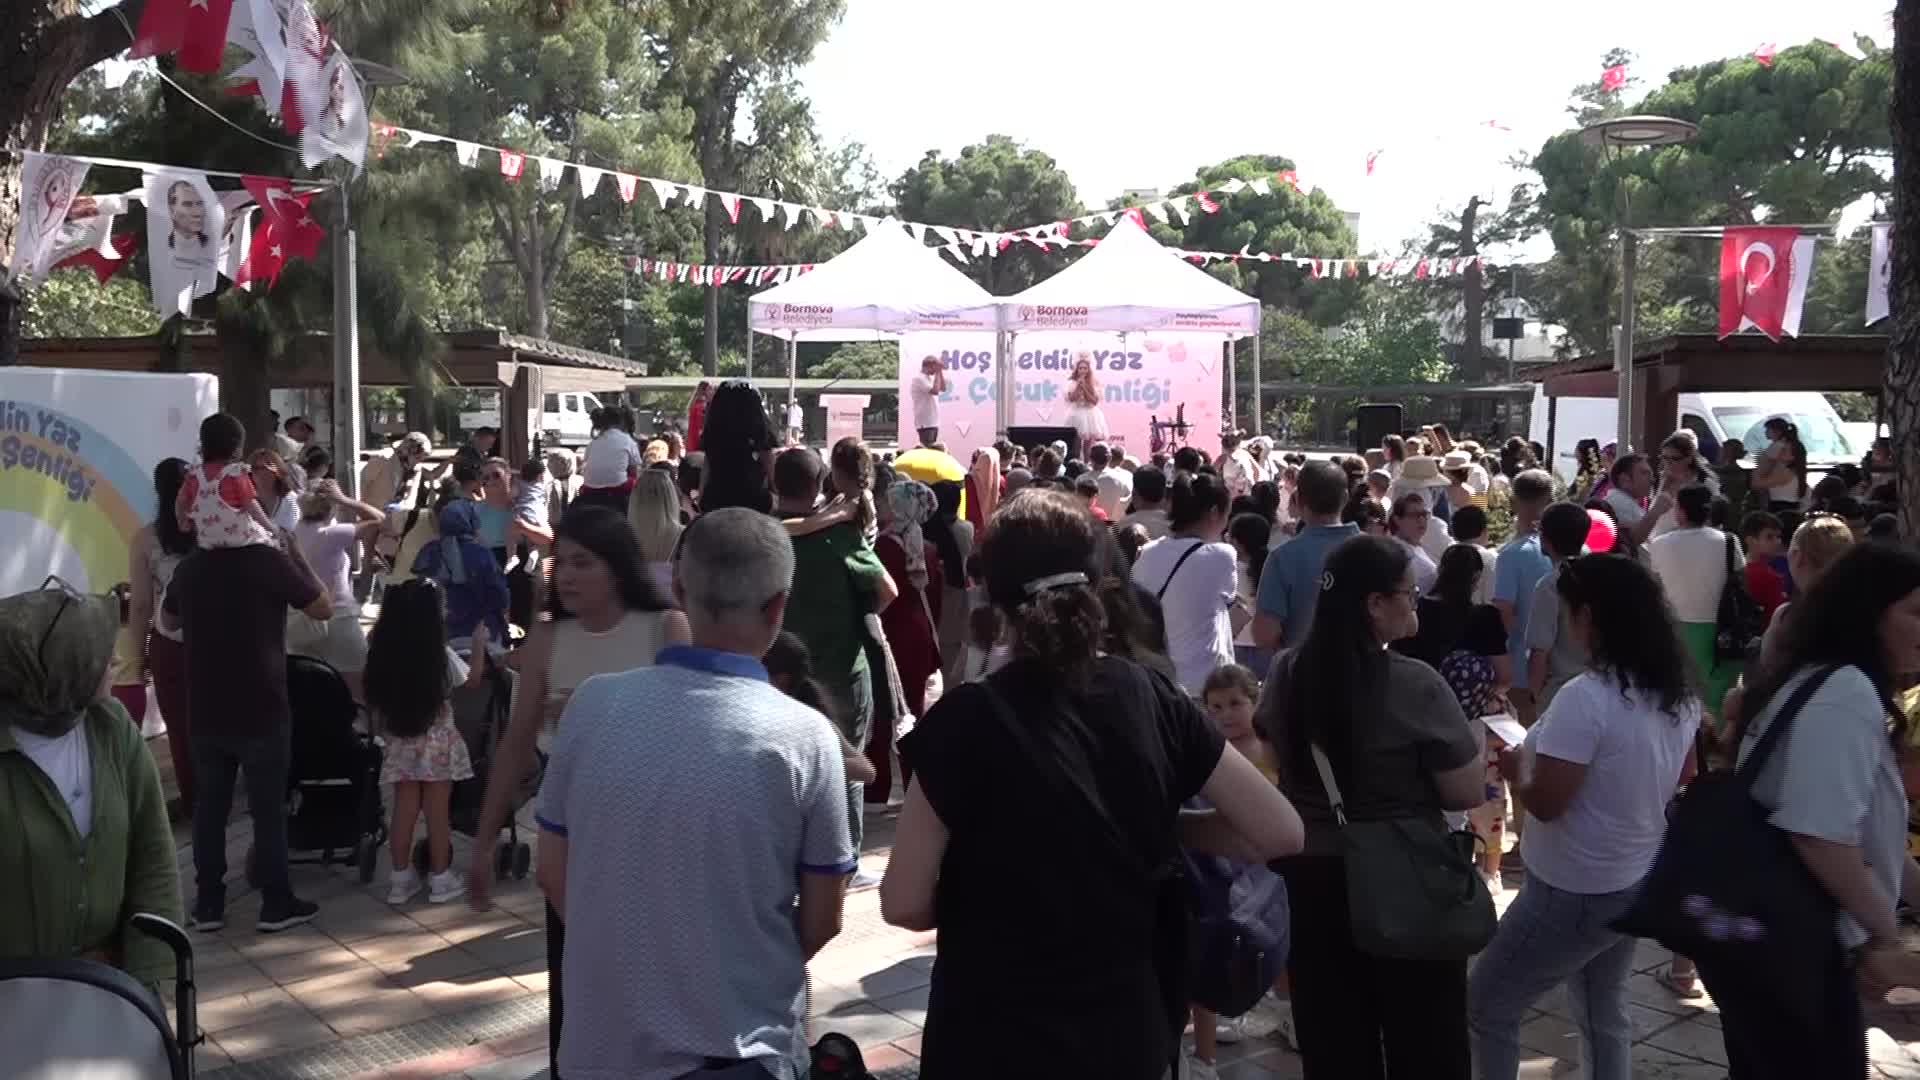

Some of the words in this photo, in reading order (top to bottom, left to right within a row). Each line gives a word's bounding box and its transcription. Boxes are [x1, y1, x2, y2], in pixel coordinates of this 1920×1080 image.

[784, 303, 833, 314] Bornova
[1037, 305, 1088, 316] Bornova
[1037, 316, 1088, 328] Belediyesi
[941, 349, 992, 373] Hoş
[1016, 348, 1073, 371] eldi
[1092, 350, 1143, 371] Yaz
[37, 409, 81, 453] Yaz
